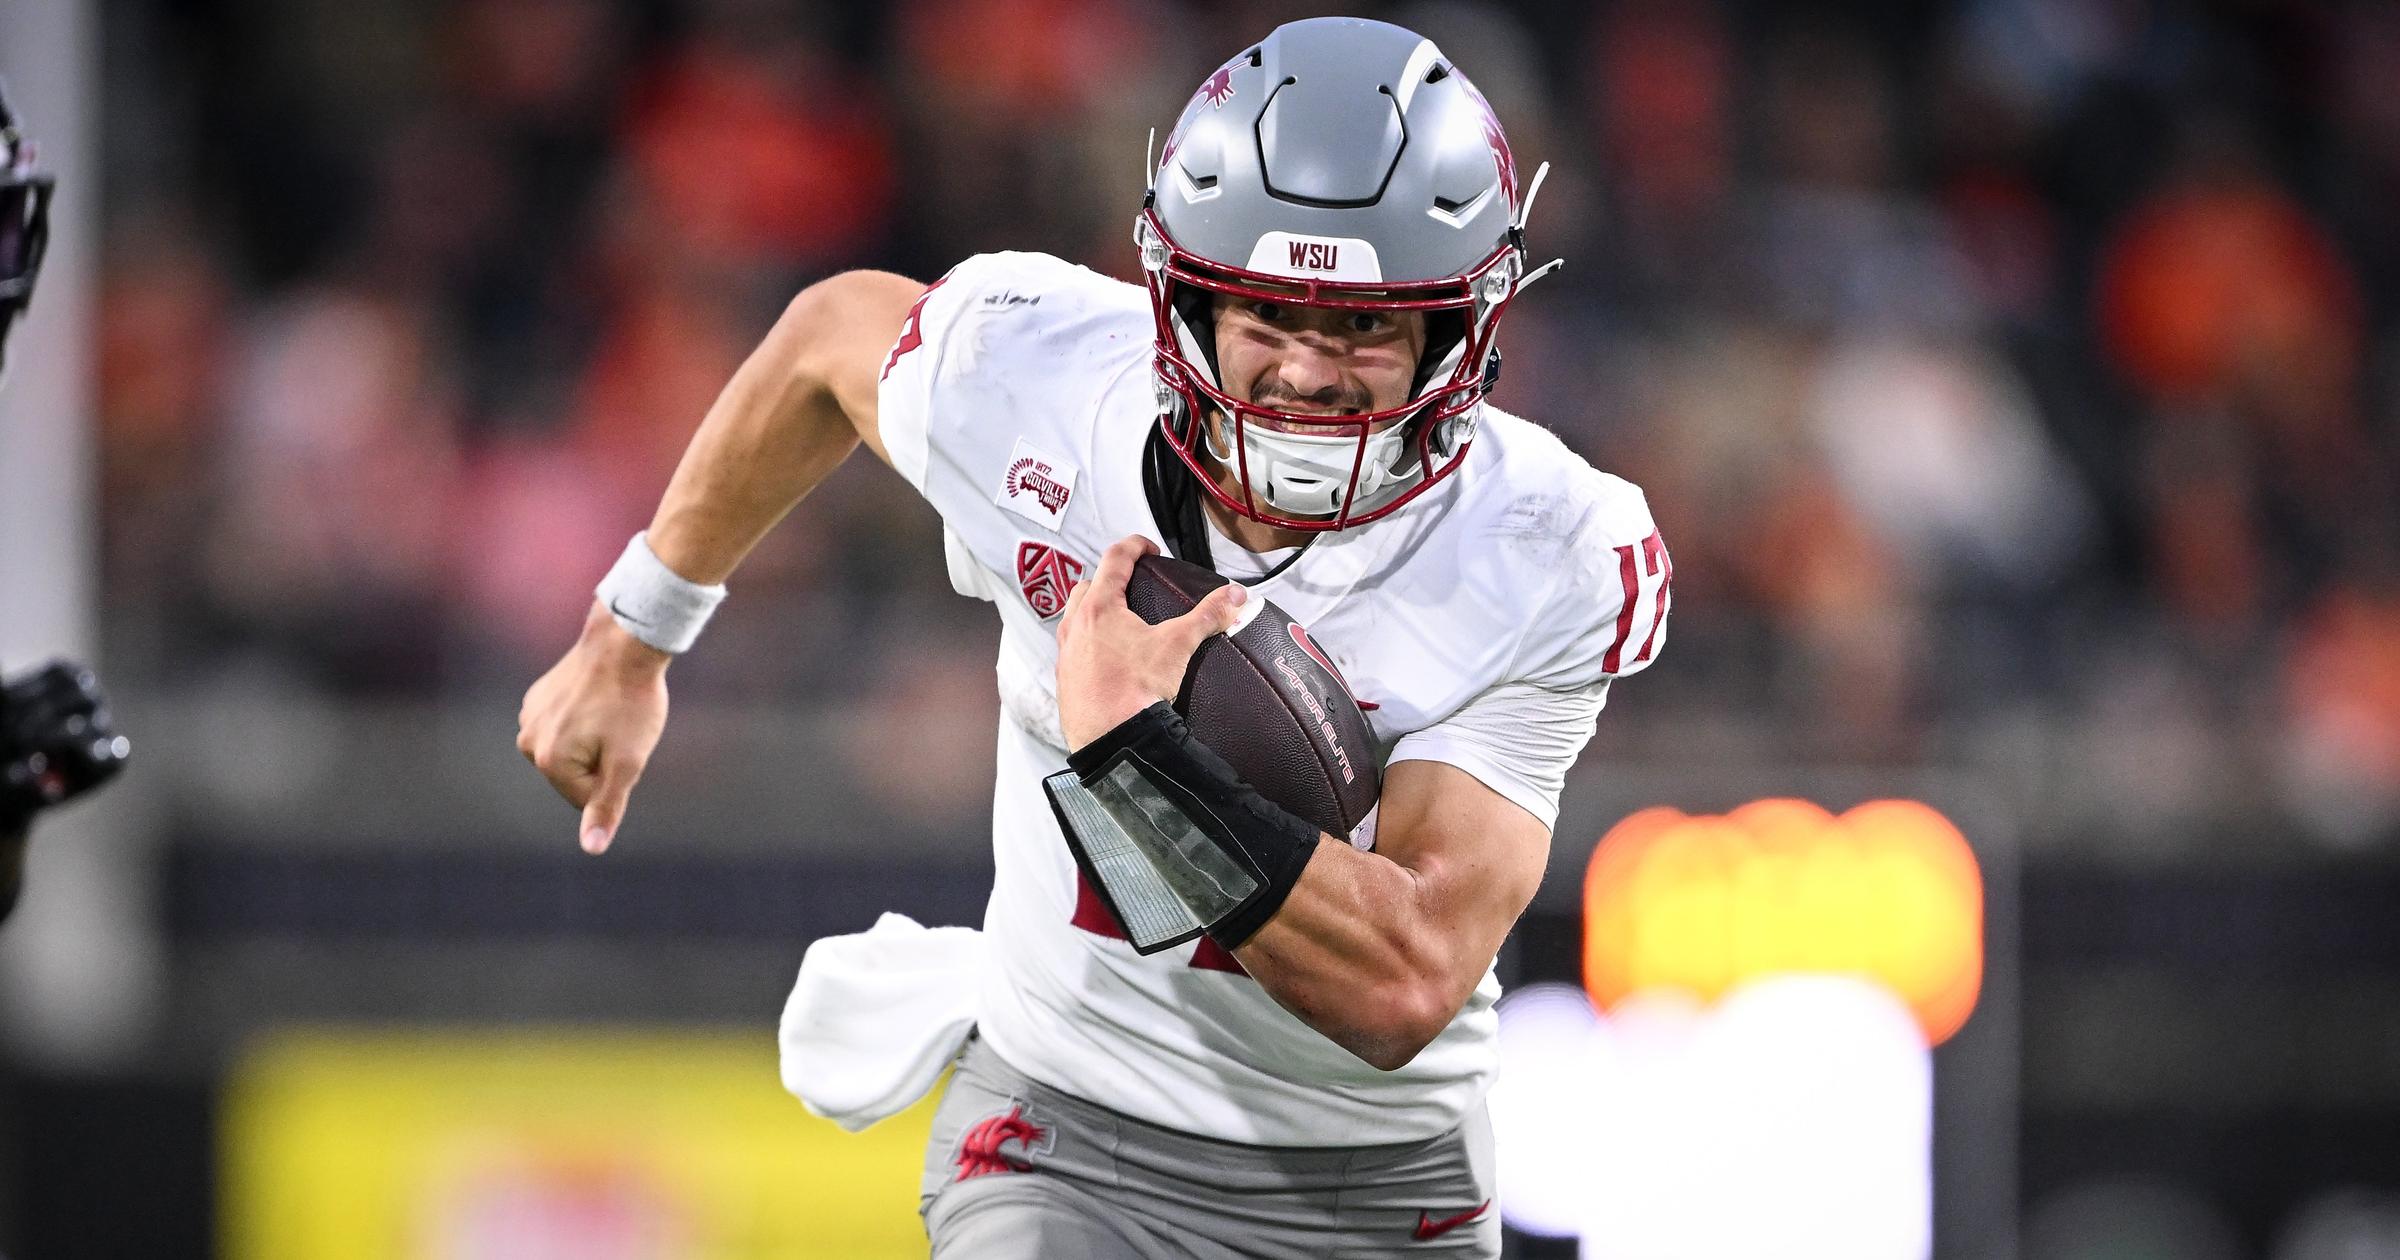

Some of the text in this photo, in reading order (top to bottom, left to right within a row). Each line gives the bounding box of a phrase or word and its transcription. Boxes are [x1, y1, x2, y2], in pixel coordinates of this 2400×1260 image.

[1288, 240, 1338, 271] WSU
[1024, 471, 1067, 500] COLVILLE
[1602, 526, 1673, 674] 17
[1274, 655, 1355, 785] VAPOR ELITE
